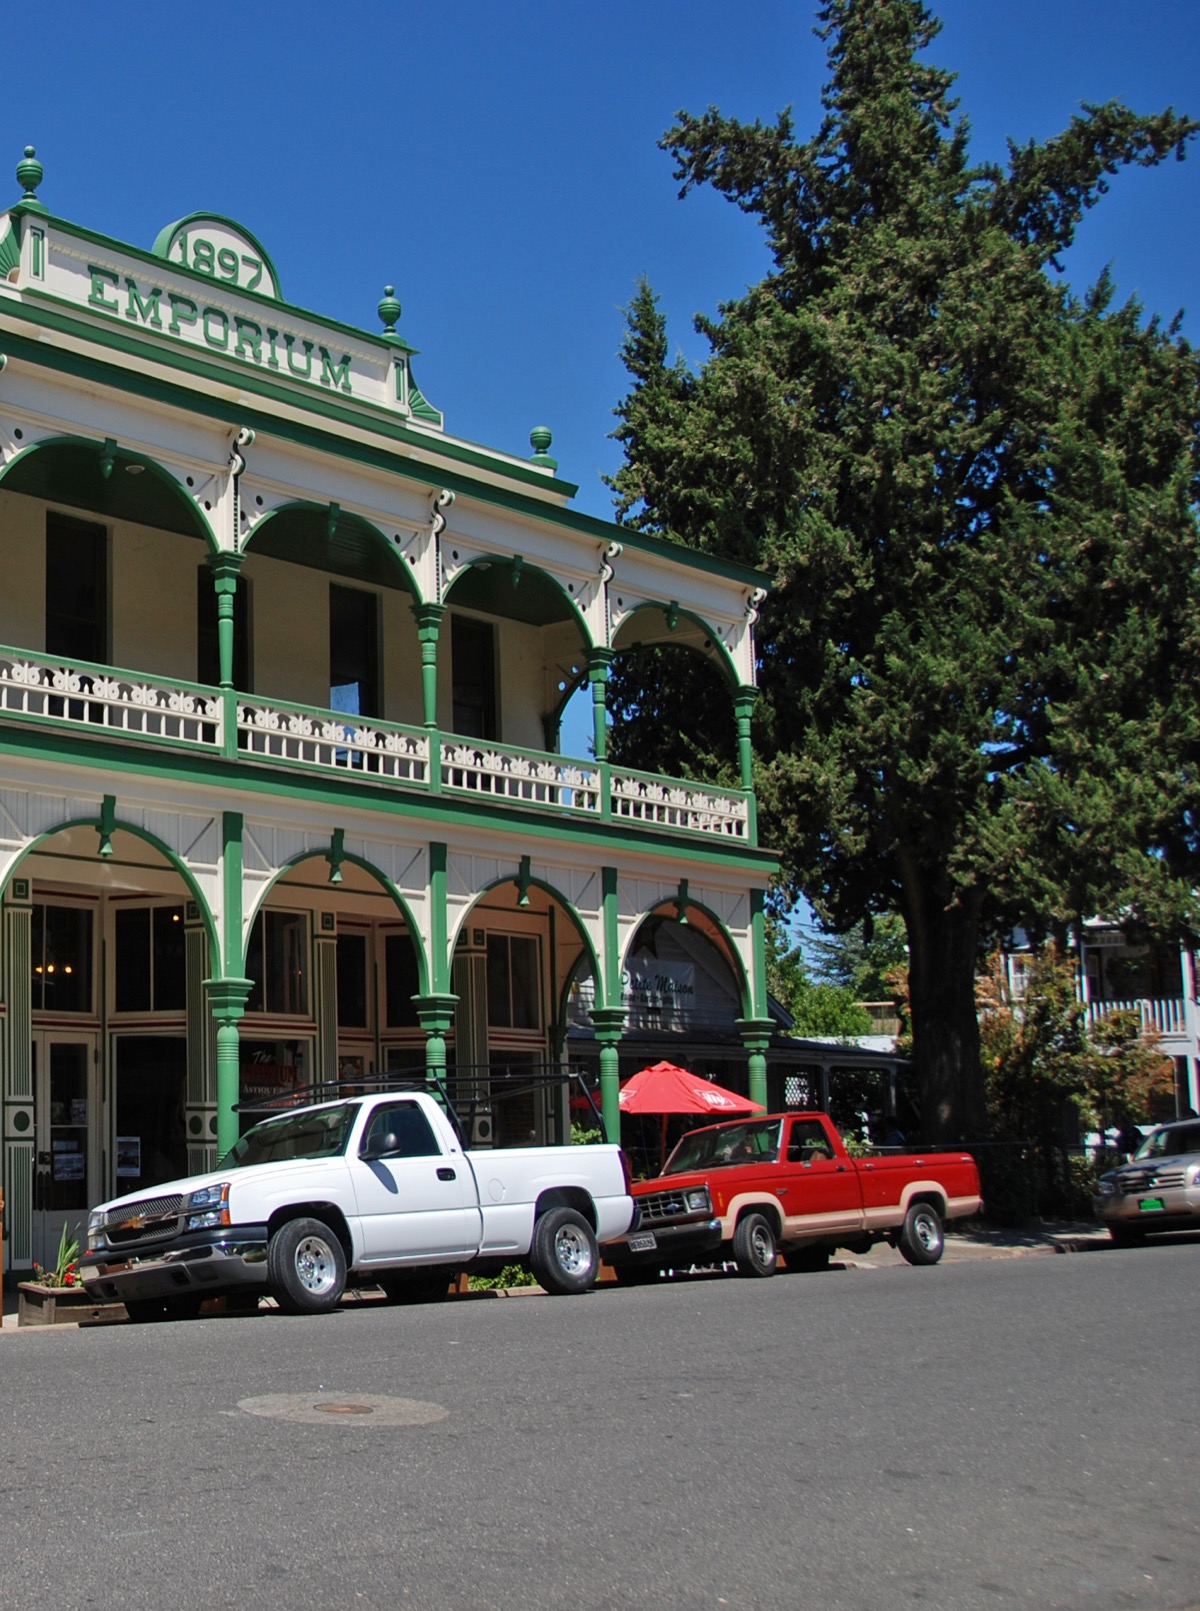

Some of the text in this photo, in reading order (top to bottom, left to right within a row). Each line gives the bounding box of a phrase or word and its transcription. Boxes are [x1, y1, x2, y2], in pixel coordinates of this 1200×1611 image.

[179, 232, 263, 291] 1897
[86, 264, 353, 392] EMPORIUM
[654, 974, 695, 995] Maison
